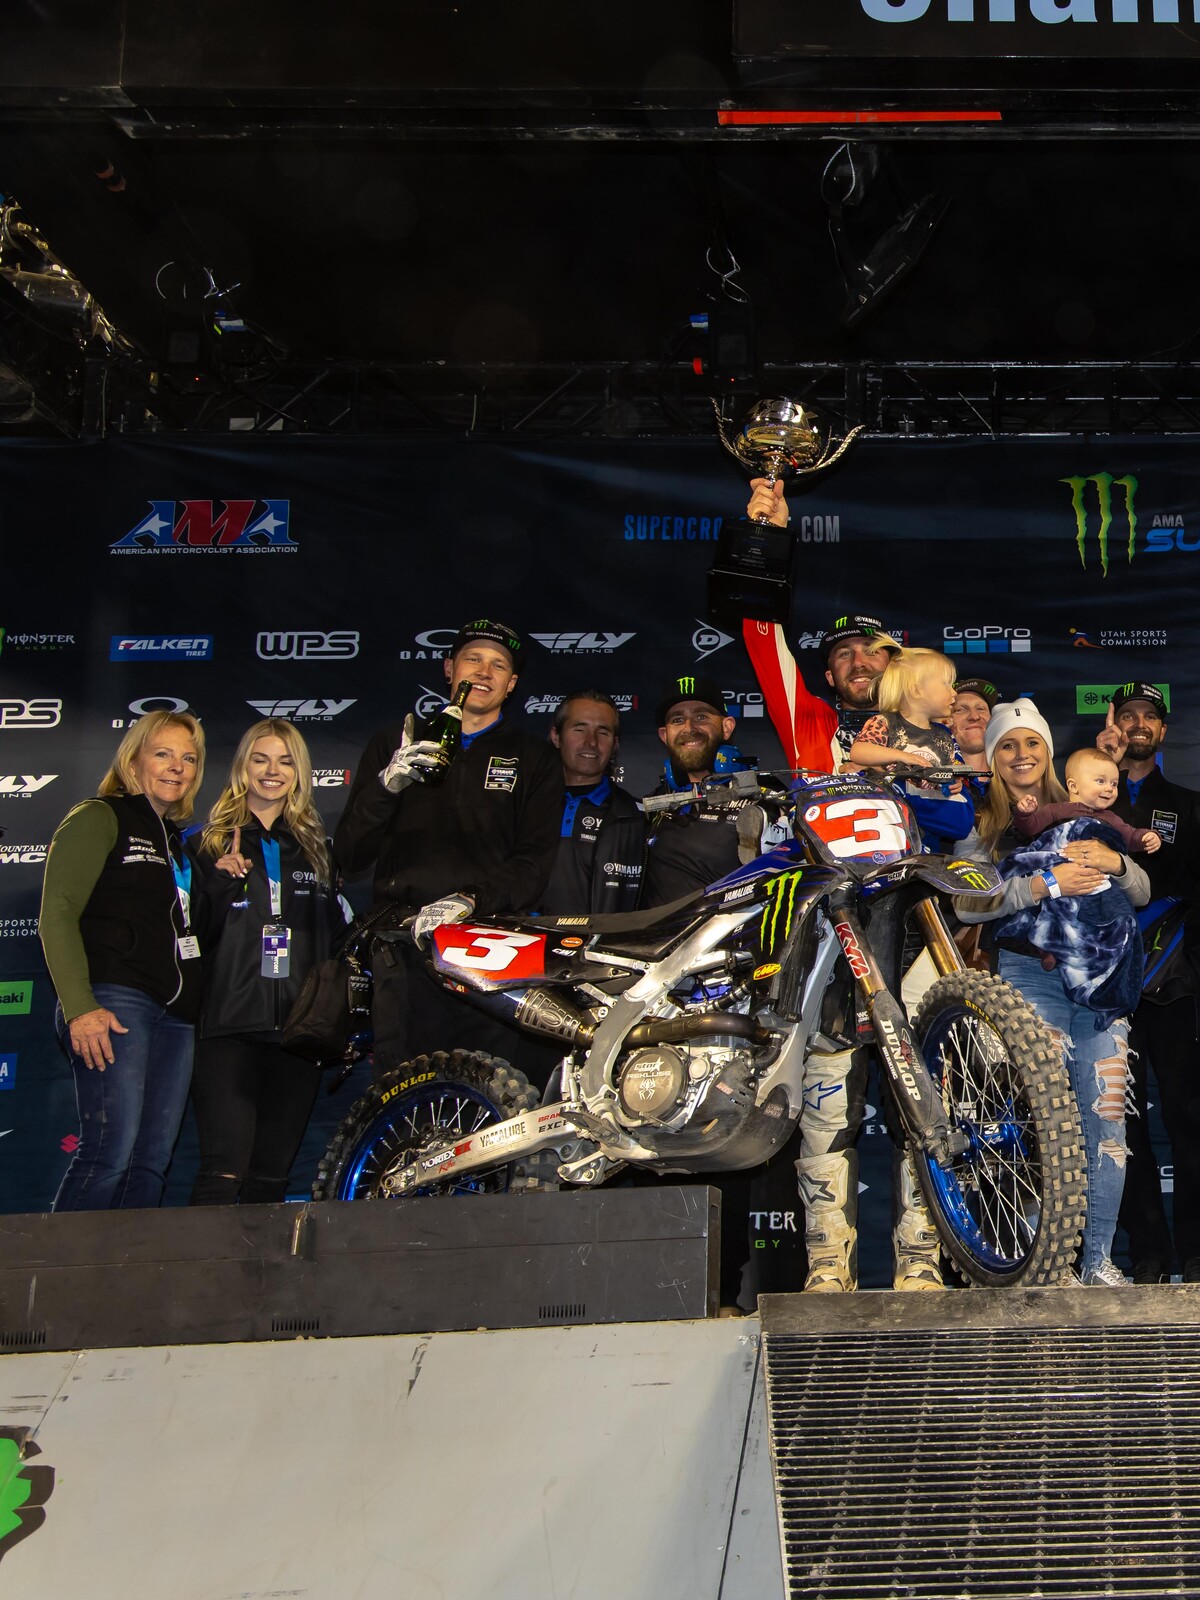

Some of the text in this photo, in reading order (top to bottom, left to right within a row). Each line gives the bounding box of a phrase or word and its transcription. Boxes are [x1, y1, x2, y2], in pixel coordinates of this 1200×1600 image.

[108, 499, 300, 547] AMA
[1152, 514, 1184, 528] AMA
[162, 547, 233, 555] MOTORCYCLIST
[235, 546, 298, 554] ASSOCIATION
[528, 632, 637, 649] FLY
[943, 626, 1031, 640] GoPro
[1130, 629, 1167, 637] SPORTS
[118, 638, 209, 651] FALKEN
[256, 630, 359, 660] WPS
[721, 690, 763, 703] Pro
[0, 699, 62, 729] PS
[247, 699, 358, 717] FLY
[0, 774, 59, 792] LY
[826, 799, 907, 858] 3
[556, 917, 589, 926] YAMAHA
[0, 929, 39, 937] ISSION
[442, 928, 541, 971] 3
[880, 1019, 921, 1101] DUNLOP
[381, 1072, 436, 1104] DUNLOP
[538, 1119, 569, 1134] EXCE
